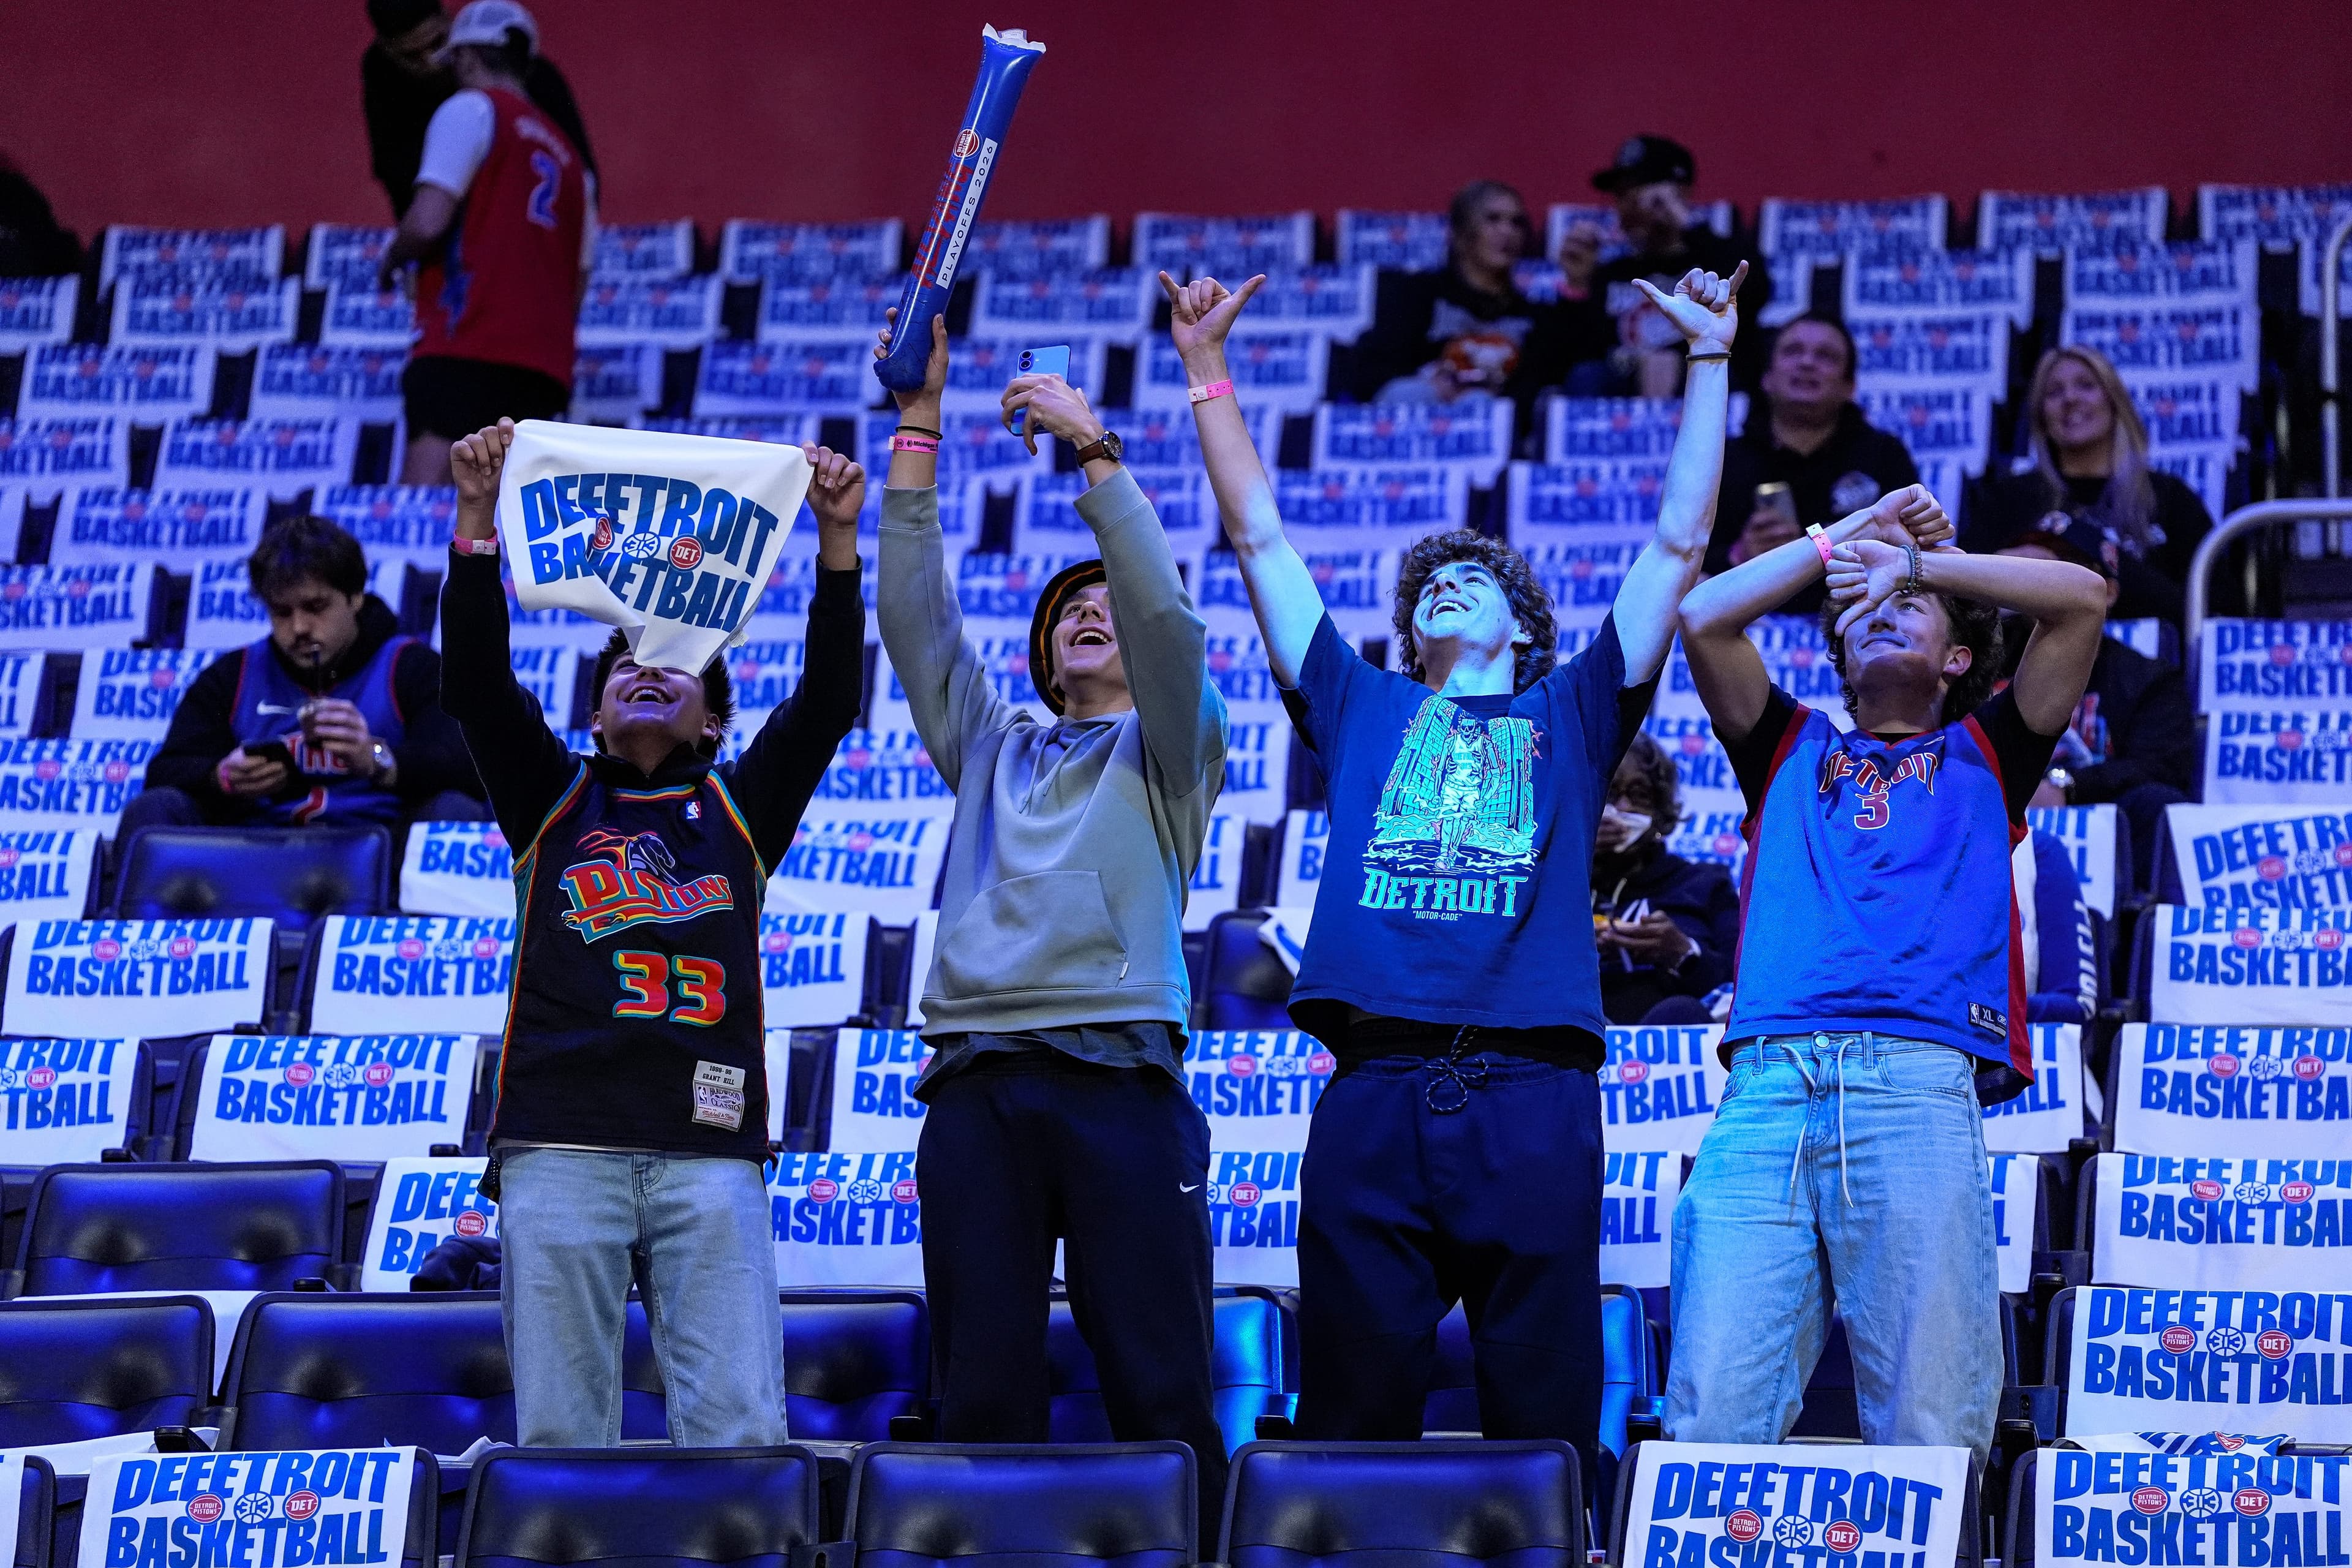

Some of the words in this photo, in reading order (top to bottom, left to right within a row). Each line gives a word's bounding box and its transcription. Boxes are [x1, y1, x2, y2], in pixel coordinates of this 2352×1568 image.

[941, 196, 976, 282] PLAYOFFS
[974, 145, 993, 189] 2026
[520, 473, 778, 578] DEEETROIT
[676, 546, 698, 562] DET
[529, 532, 752, 633] BAKETBALL
[0, 589, 134, 629] SKETBALL
[2217, 622, 2352, 657] DEEETR
[2217, 663, 2352, 696] BASKET
[2218, 744, 2352, 782] BASKET
[0, 774, 145, 813] ASKETB
[815, 766, 955, 801] ASKETB
[1854, 791, 1890, 830] 3
[780, 845, 916, 888] KETBALL
[2193, 812, 2352, 883] DEEETR
[559, 859, 734, 940] PISTONS
[1358, 866, 1529, 917] DETROIT
[2203, 867, 2352, 910] BASKET
[32, 918, 253, 950] DEEETROIT
[338, 918, 516, 948] DEEETRO
[2172, 907, 2352, 937] DEEETRO
[26, 951, 249, 996] BASKETBALL
[332, 953, 512, 997] BASKETBA
[2169, 941, 2352, 987] BASKETB
[612, 950, 726, 1028] 33
[1982, 1008, 1995, 1022] XL
[0, 1039, 124, 1075] TROIT
[223, 1036, 461, 1076] DEEETROIT
[2144, 1025, 2352, 1063] DEEETRO
[702, 1073, 721, 1082] GRANT
[2299, 1062, 2320, 1073] DET
[0, 1080, 113, 1130] TBALL
[215, 1077, 448, 1126] BASKETBALL
[709, 1087, 741, 1101] HARDWOOD
[710, 1098, 741, 1112] CLASSICS
[1601, 1069, 1714, 1125] TBALL
[2141, 1068, 2352, 1121] BASKETBA
[764, 1152, 917, 1187] EEETR
[2123, 1153, 2352, 1188] DEEETROI
[1235, 1189, 1256, 1200] DET
[2286, 1186, 2309, 1198] DET
[771, 1194, 922, 1246] ASKETB
[2120, 1191, 2352, 1247] BASKETBAL
[2209, 1333, 2244, 1351] 313
[2263, 1338, 2286, 1350] DET
[111, 1451, 401, 1515] DEEETROIT
[2053, 1451, 2350, 1505] DEEETROIT
[192, 1507, 217, 1515] PISTONS
[236, 1496, 272, 1519] 313
[290, 1498, 315, 1512] DET
[1651, 1461, 1943, 1546] DEEETROIT
[2182, 1493, 2220, 1512] 313
[2239, 1495, 2264, 1507] DET
[105, 1509, 388, 1568] BASKETBALL
[1732, 1524, 1756, 1532] PISTONS
[1733, 1517, 1757, 1527] DETROIT
[1776, 1521, 1811, 1540] 313
[1830, 1530, 1856, 1545] DET
[2052, 1504, 2350, 1568] BASKETBALL
